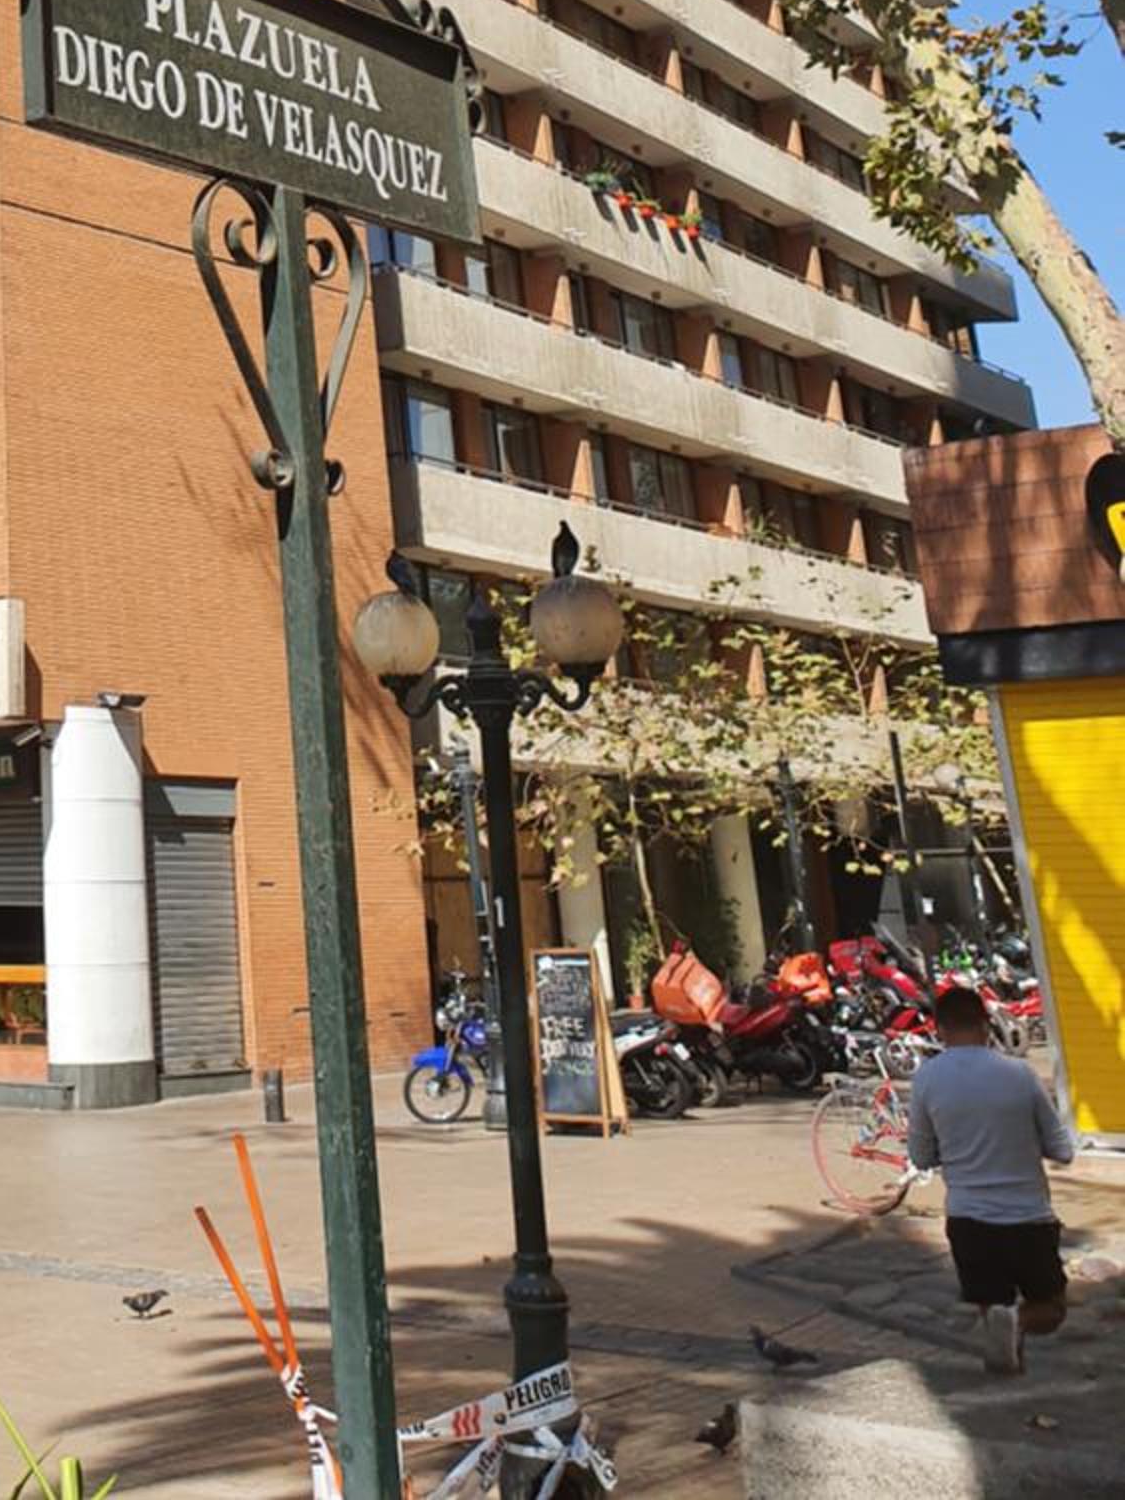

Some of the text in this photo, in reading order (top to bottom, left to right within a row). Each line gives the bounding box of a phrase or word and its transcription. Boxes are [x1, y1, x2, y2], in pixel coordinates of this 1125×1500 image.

[53, 25, 448, 202] DIEGO DE VELASQUEZ
[503, 1367, 572, 1412] PELIGRO
